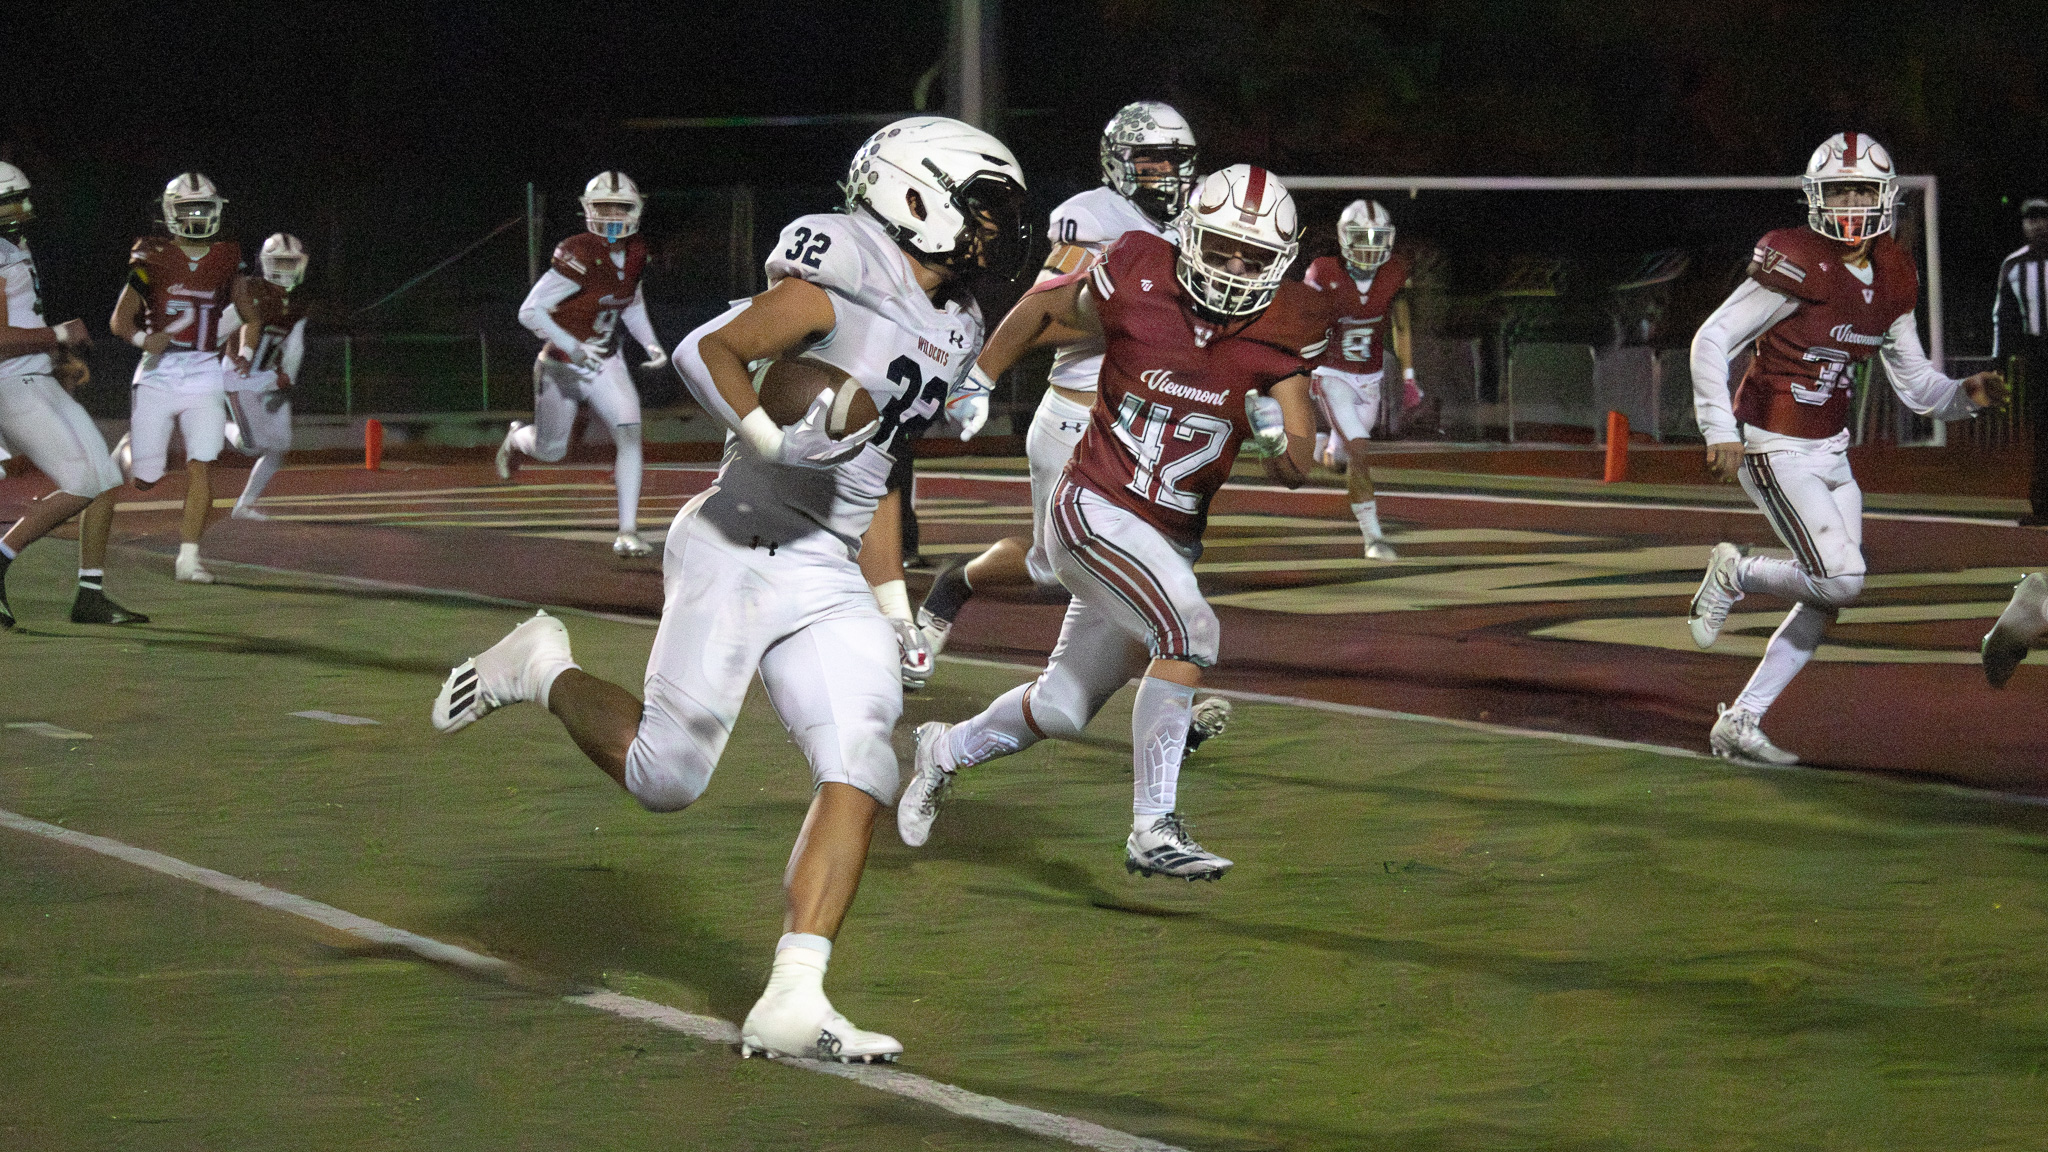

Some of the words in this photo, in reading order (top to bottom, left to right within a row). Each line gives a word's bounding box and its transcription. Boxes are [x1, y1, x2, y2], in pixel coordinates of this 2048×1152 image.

[785, 227, 832, 270] 32
[1059, 216, 1078, 242] 10
[165, 300, 215, 350] 21
[917, 335, 949, 367] WILDCATS
[1140, 369, 1230, 406] Viewmont
[1790, 347, 1850, 406] 3
[1110, 391, 1234, 515] 42
